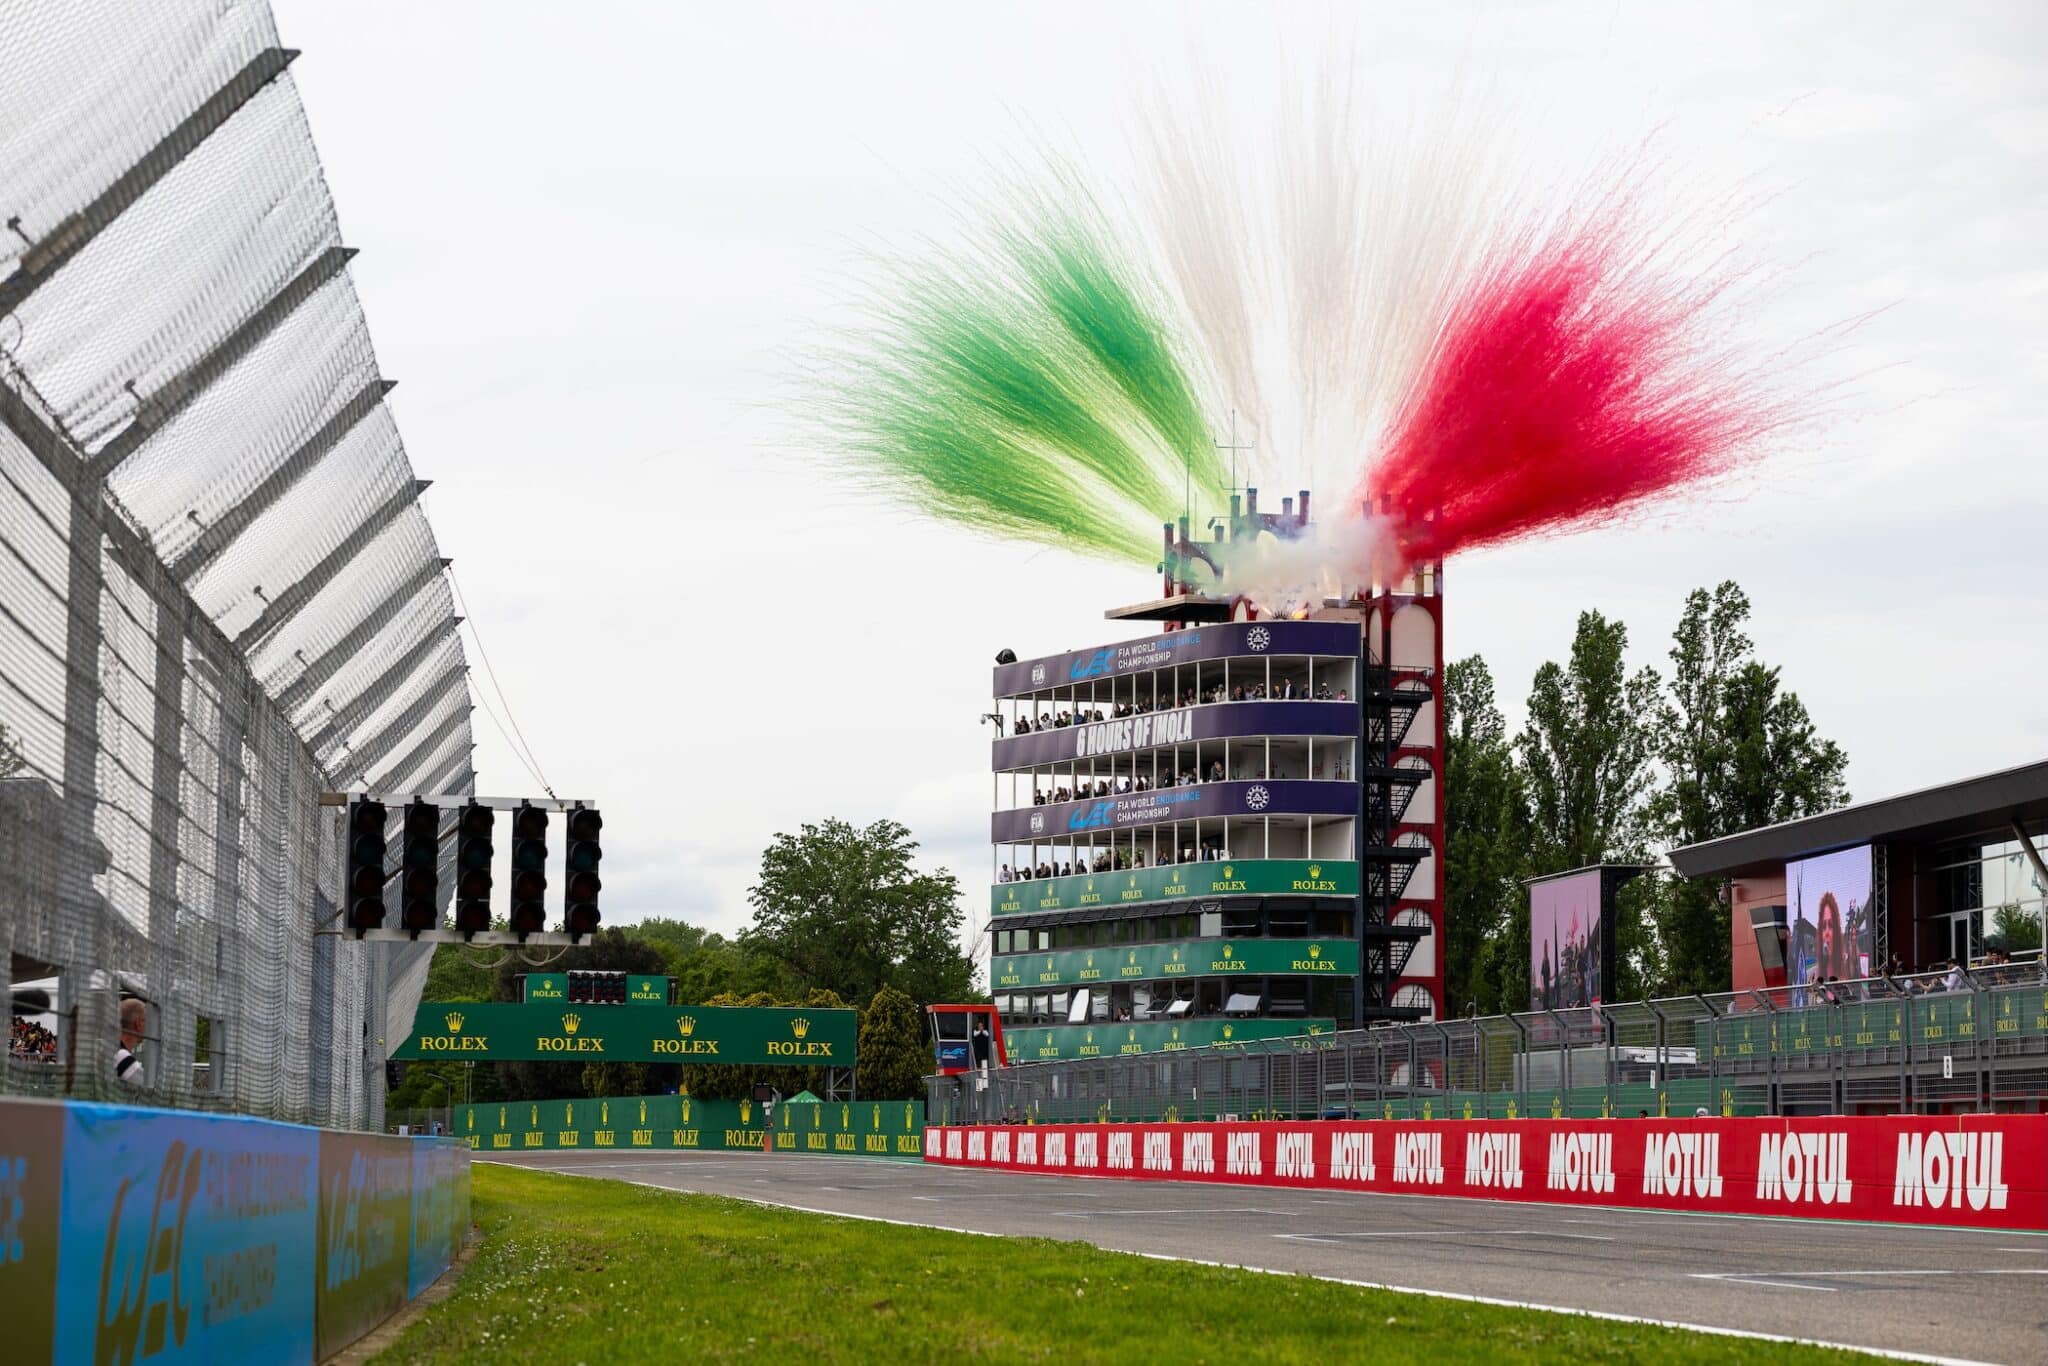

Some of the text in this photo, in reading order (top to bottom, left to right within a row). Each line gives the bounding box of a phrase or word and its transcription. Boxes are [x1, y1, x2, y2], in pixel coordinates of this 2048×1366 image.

[1118, 647, 1130, 657] FIA
[1131, 642, 1156, 654] WORLD
[1118, 651, 1171, 669] CHAMPIONSHIP
[1076, 709, 1193, 757] 6 HOURS OF IMOLA
[1117, 801, 1129, 811] FIA
[1130, 797, 1155, 809] WORLD
[1117, 806, 1170, 823] CHAMPIONSHIP
[1164, 885, 1187, 896] ROLEX
[1212, 880, 1246, 891] ROLEX
[1292, 880, 1337, 891] ROLEX
[1040, 897, 1061, 908] ROLEX
[1080, 893, 1101, 904] ROLEX
[1122, 889, 1143, 900] ROLEX
[1000, 902, 1021, 912] ROLEX
[1121, 966, 1143, 976] ROLEX
[1164, 963, 1186, 973] ROLEX
[1212, 960, 1246, 971] ROLEX
[1292, 960, 1336, 971] ROLEX
[1000, 975, 1021, 985] ROLEX
[1039, 972, 1060, 982] ROLEX
[1080, 969, 1101, 979] ROLEX
[533, 985, 563, 998] ROLEX
[631, 988, 662, 1000] ROLEX
[421, 1036, 488, 1051] ROLEX
[537, 1037, 604, 1052] ROLEX
[653, 1039, 719, 1055] ROLEX
[767, 1041, 833, 1056] ROLEX
[1080, 1046, 1100, 1055] ROLEX
[1121, 1044, 1142, 1053] ROLEX
[1040, 1048, 1059, 1057] ROLEX
[493, 1132, 513, 1148] ROLEX
[525, 1131, 544, 1146] ROLEX
[559, 1131, 579, 1146] ROLEX
[594, 1130, 615, 1146] ROLEX
[632, 1130, 653, 1146] ROLEX
[672, 1129, 699, 1146] ROLEX
[725, 1130, 765, 1147] ROLEX
[777, 1132, 796, 1149] ROLEX
[807, 1132, 827, 1150] ROLEX
[835, 1133, 856, 1151] ROLEX
[865, 1135, 888, 1153] ROLEX
[897, 1135, 920, 1153] ROLEX
[926, 1129, 942, 1157] MOTUL
[946, 1131, 962, 1159] MOTUL
[968, 1131, 985, 1161] MOTUL
[991, 1132, 1010, 1163] MOTUL
[1016, 1132, 1037, 1164] MOTUL
[1044, 1132, 1067, 1167] MOTUL
[1074, 1132, 1099, 1168] MOTUL
[1106, 1132, 1134, 1169] MOTUL
[1143, 1132, 1172, 1171] MOTUL
[1182, 1132, 1215, 1174] MOTUL
[1226, 1132, 1262, 1176] MOTUL
[1276, 1132, 1315, 1178] MOTUL
[1330, 1132, 1376, 1182] MOTUL
[1394, 1132, 1445, 1185] MOTUL
[1465, 1132, 1523, 1189] MOTUL
[1547, 1132, 1616, 1193] MOTUL
[1642, 1131, 1723, 1198] MOTUL
[1756, 1131, 1853, 1205] MOTUL
[1893, 1131, 2009, 1211] MOTUL
